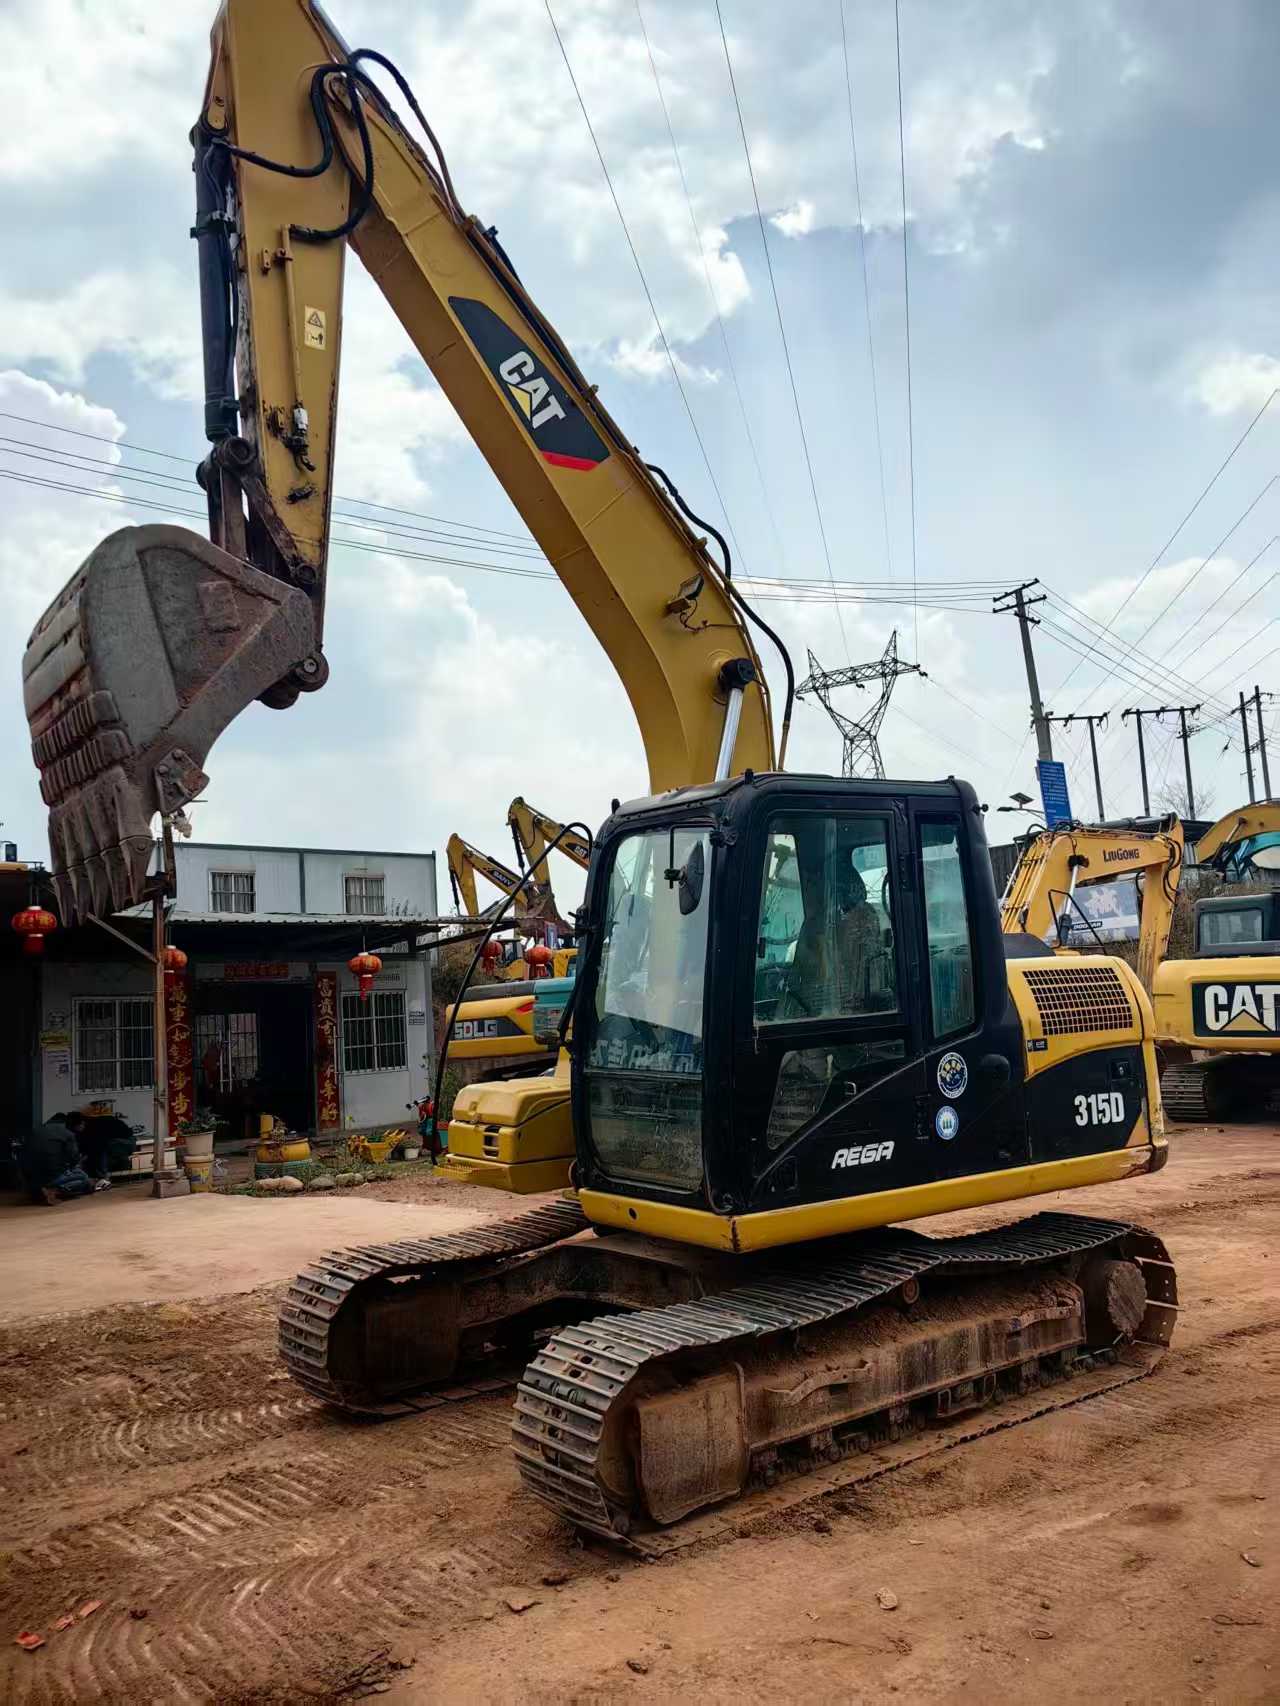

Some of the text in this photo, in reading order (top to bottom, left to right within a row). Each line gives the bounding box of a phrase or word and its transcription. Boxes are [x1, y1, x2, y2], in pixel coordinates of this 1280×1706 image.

[500, 351, 567, 430] CAT
[1204, 984, 1280, 1031] CAT
[1074, 1092, 1125, 1127] 315D
[831, 1140, 896, 1170] REGA
